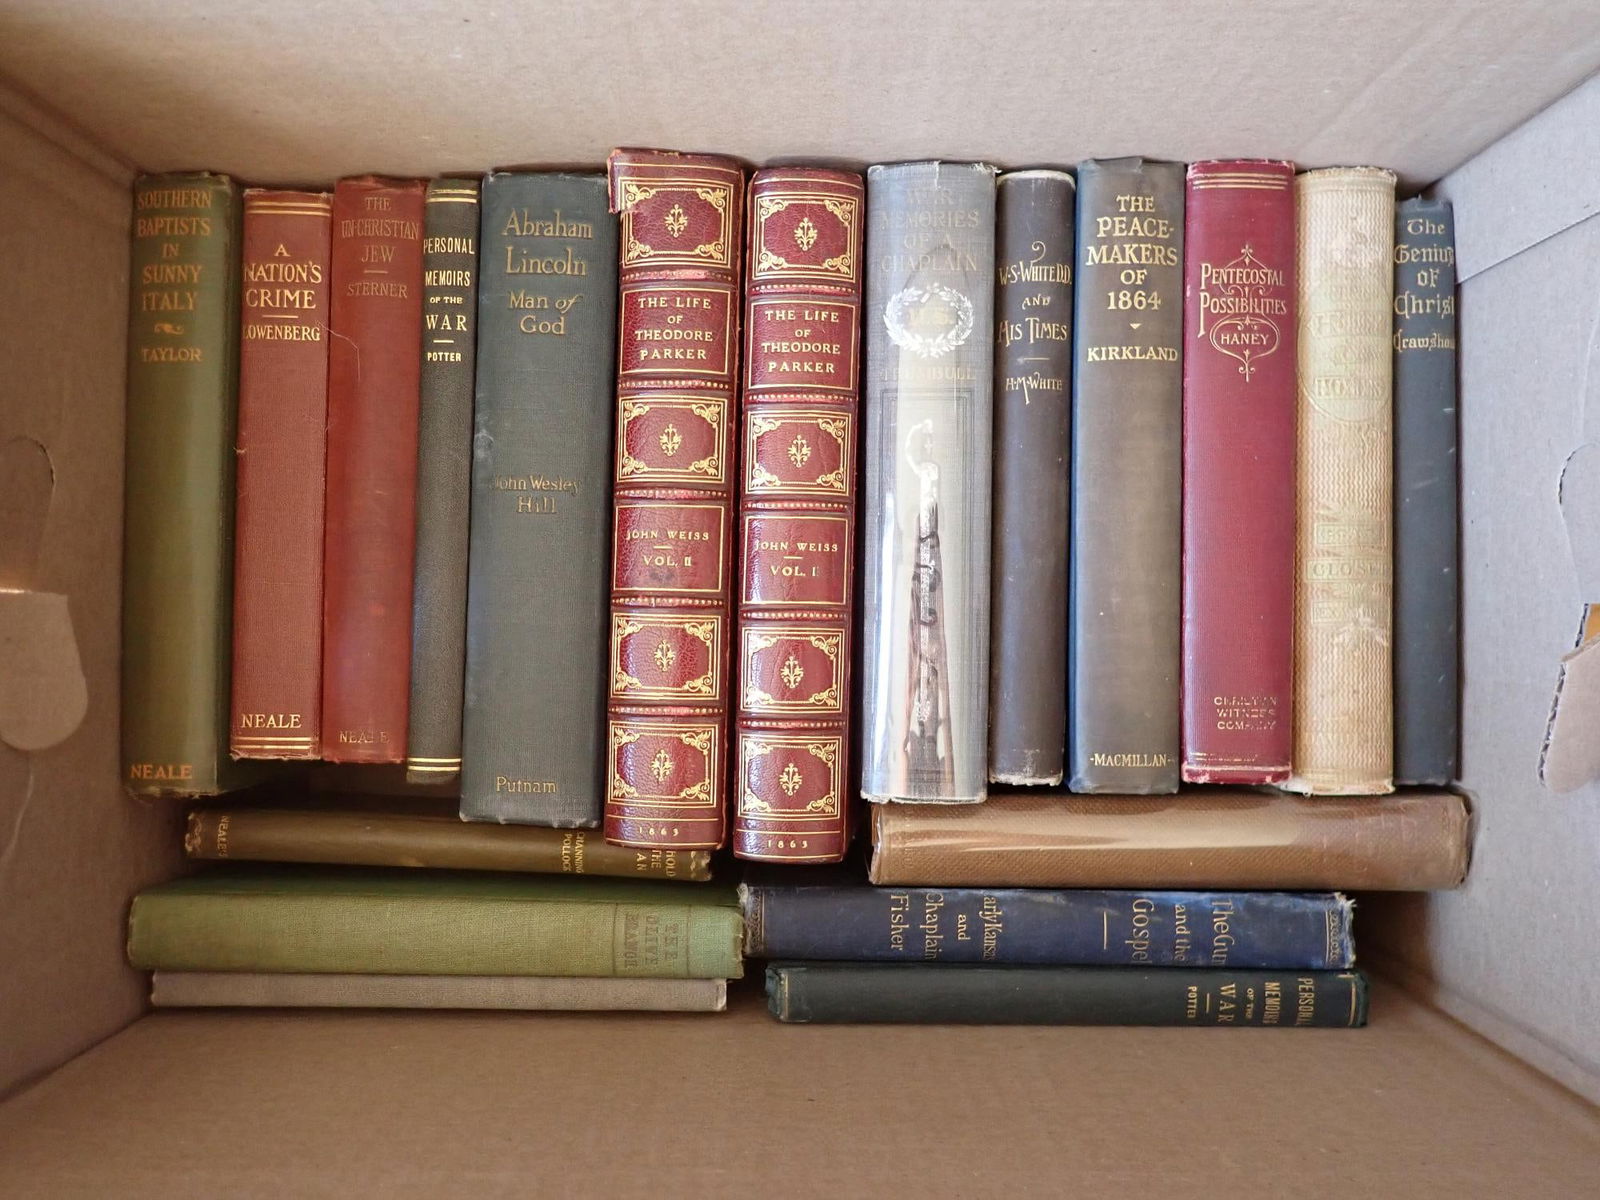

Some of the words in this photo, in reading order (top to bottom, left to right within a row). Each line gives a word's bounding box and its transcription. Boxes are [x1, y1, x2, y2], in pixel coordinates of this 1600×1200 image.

[137, 190, 212, 209] SOUTHERN
[364, 197, 392, 212] THE
[1116, 195, 1155, 212] THE
[137, 217, 211, 237] BAPTISTS
[502, 208, 593, 239] Abraham
[1096, 217, 1174, 238] PEACE-
[1407, 219, 1446, 235] The
[162, 243, 180, 259] IN
[274, 244, 290, 257] A
[361, 245, 397, 263] JEW
[424, 238, 475, 255] PERSONAL
[1085, 243, 1178, 266] MAKERS
[505, 246, 588, 276] Lincoln
[880, 255, 978, 272] CHAPLAIN
[142, 265, 202, 284] SUNNY
[244, 261, 322, 284] NATION'S
[425, 270, 471, 287] MEMOIRS
[1120, 269, 1148, 285] OF
[1200, 263, 1286, 289] PENTECOSTAL
[347, 282, 408, 298] STERNER
[142, 292, 198, 312] ITALY
[246, 289, 317, 309] CRIME
[508, 289, 549, 309] Man
[555, 293, 584, 314] of
[638, 297, 667, 309] THE
[676, 298, 711, 309] LIFE
[1107, 290, 1161, 311] 1864
[667, 315, 683, 325] OF
[765, 310, 796, 321] THE
[805, 311, 839, 323] LIFE
[1198, 292, 1287, 334] POSSIBILITIES
[426, 314, 467, 331] WAR
[520, 316, 566, 336] God
[243, 325, 320, 342] LOWENBERG
[635, 329, 713, 342] THEODORE
[795, 328, 811, 338] OF
[998, 319, 1022, 347] HIS
[1025, 317, 1068, 344] TIMES
[1220, 333, 1269, 346] HANEY
[761, 342, 840, 354] THEODORE
[1393, 329, 1456, 353] Crawsha
[141, 348, 202, 363] TAYLOR
[427, 352, 462, 362] POTTER
[640, 349, 706, 360] PARKER
[1087, 346, 1178, 362] KIRKLAND
[768, 362, 835, 374] PARKER
[529, 475, 581, 497] Wesley
[517, 495, 557, 513] Hill
[627, 531, 658, 541] JOHN
[667, 531, 709, 541] WEISS
[755, 541, 788, 551] JOHN
[796, 542, 838, 552] WEISS
[643, 555, 678, 568] VOL.
[684, 556, 692, 567] II
[770, 565, 806, 577] VOL.
[240, 714, 302, 729] NEALE
[130, 764, 193, 780] NEALE
[496, 776, 557, 793] Putnam
[561, 833, 571, 873] POLLOCK
[575, 832, 584, 874] CHANNING
[979, 896, 1004, 921] arly
[1211, 899, 1234, 932] The
[890, 894, 909, 951] Fisher
[919, 893, 944, 960] Chaplain
[957, 913, 971, 941] and
[1175, 903, 1190, 935] and
[1124, 898, 1154, 965] Gospel
[1174, 939, 1190, 962] the
[1217, 982, 1236, 1023] WAR
